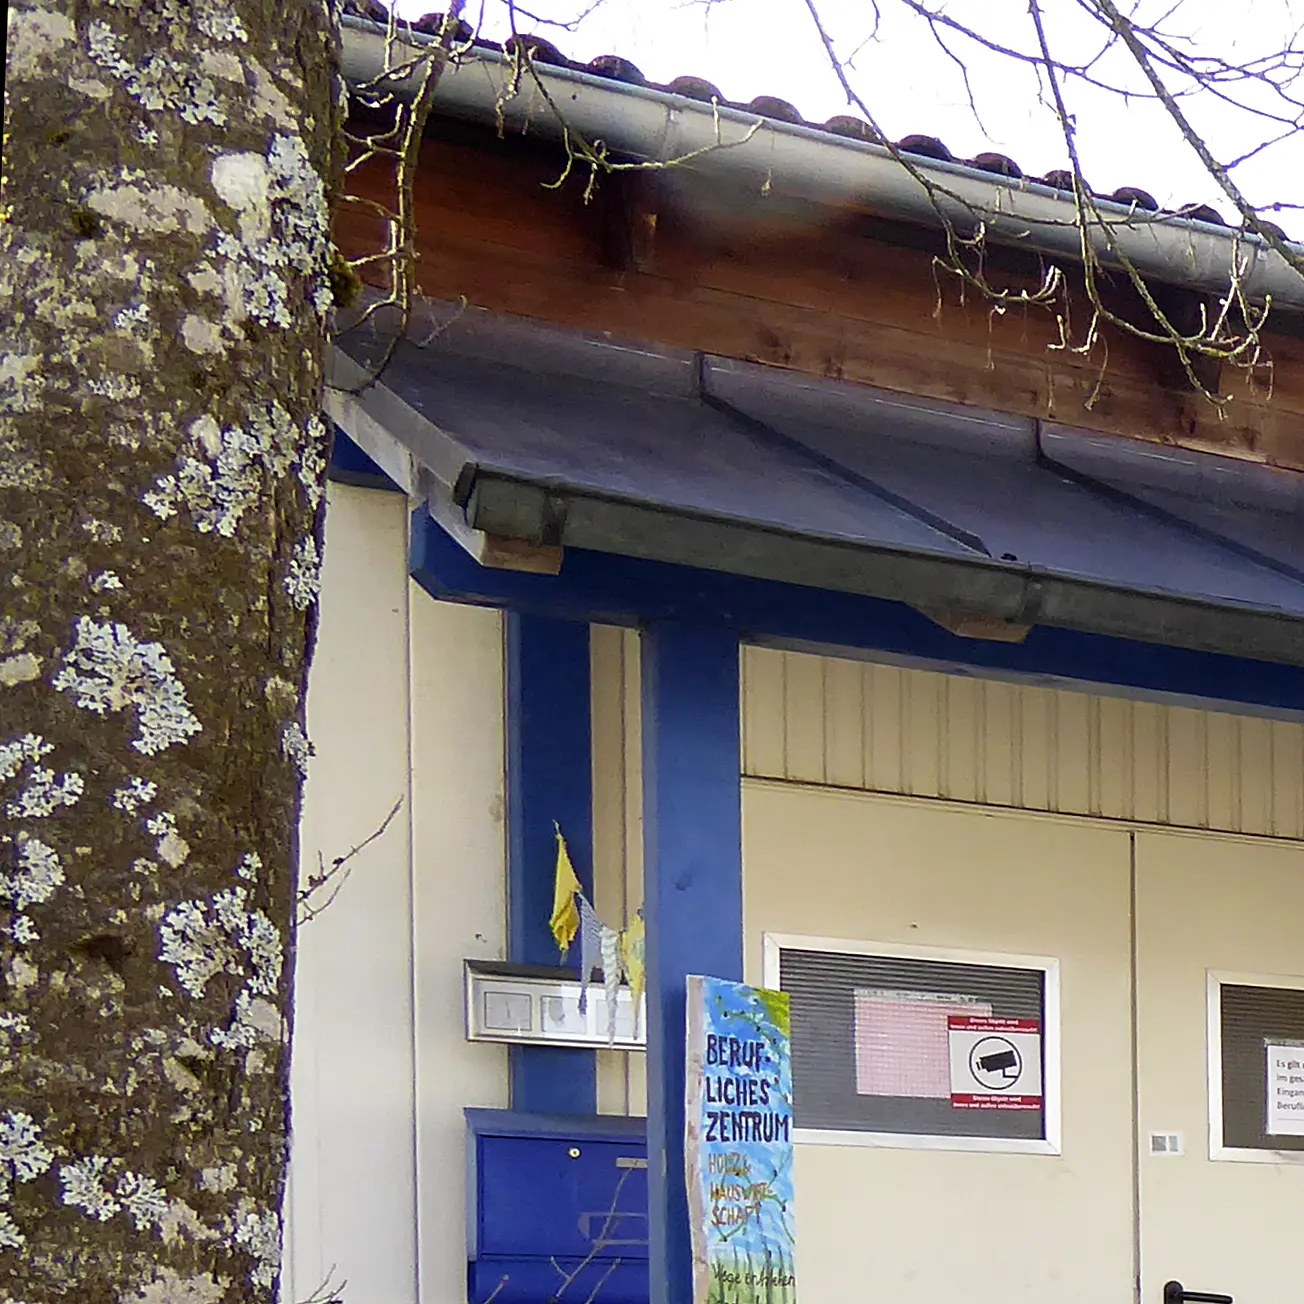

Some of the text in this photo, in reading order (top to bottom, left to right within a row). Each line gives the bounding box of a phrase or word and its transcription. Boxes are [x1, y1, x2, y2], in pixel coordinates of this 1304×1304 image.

[706, 1033, 771, 1073] BERUF-
[705, 1075, 770, 1106] LICHES
[705, 1110, 789, 1143] ZENTRUM
